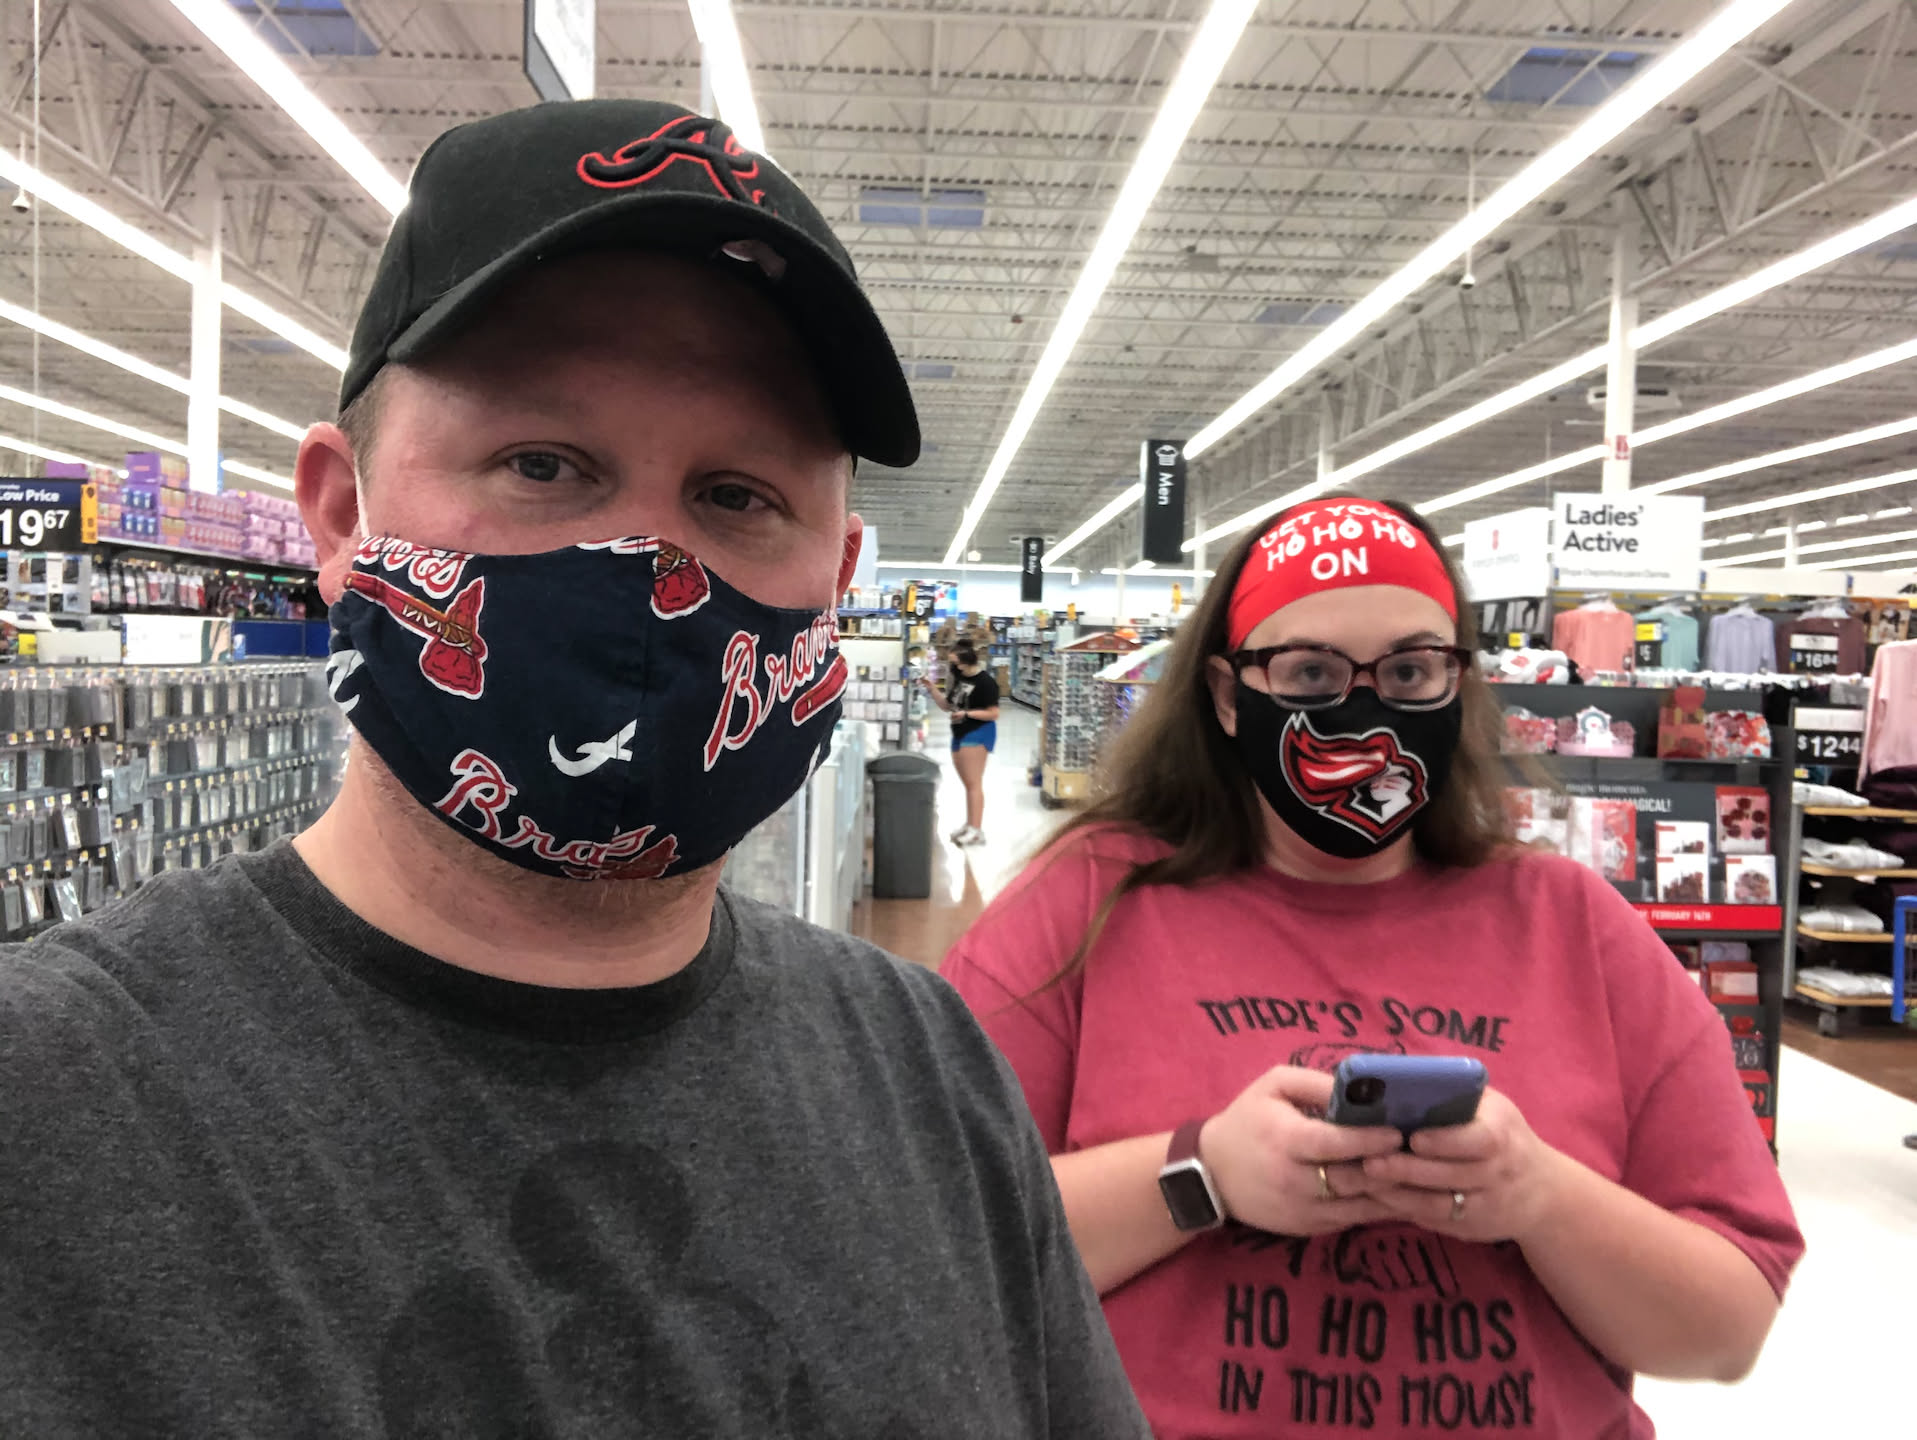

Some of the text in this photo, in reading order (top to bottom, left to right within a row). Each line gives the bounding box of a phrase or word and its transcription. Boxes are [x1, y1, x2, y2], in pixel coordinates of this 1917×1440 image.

[25, 488, 60, 502] Price
[1158, 472, 1174, 506] Men
[1260, 511, 1317, 549] GET
[1266, 515, 1416, 572] HO HO HO
[1563, 529, 1639, 553] Active
[1311, 546, 1369, 581] ON
[1196, 995, 1510, 1053] THERE'S SOME
[1224, 1283, 1518, 1364] HO HO HOS
[1219, 1359, 1535, 1430] IN THIS HOUSE
